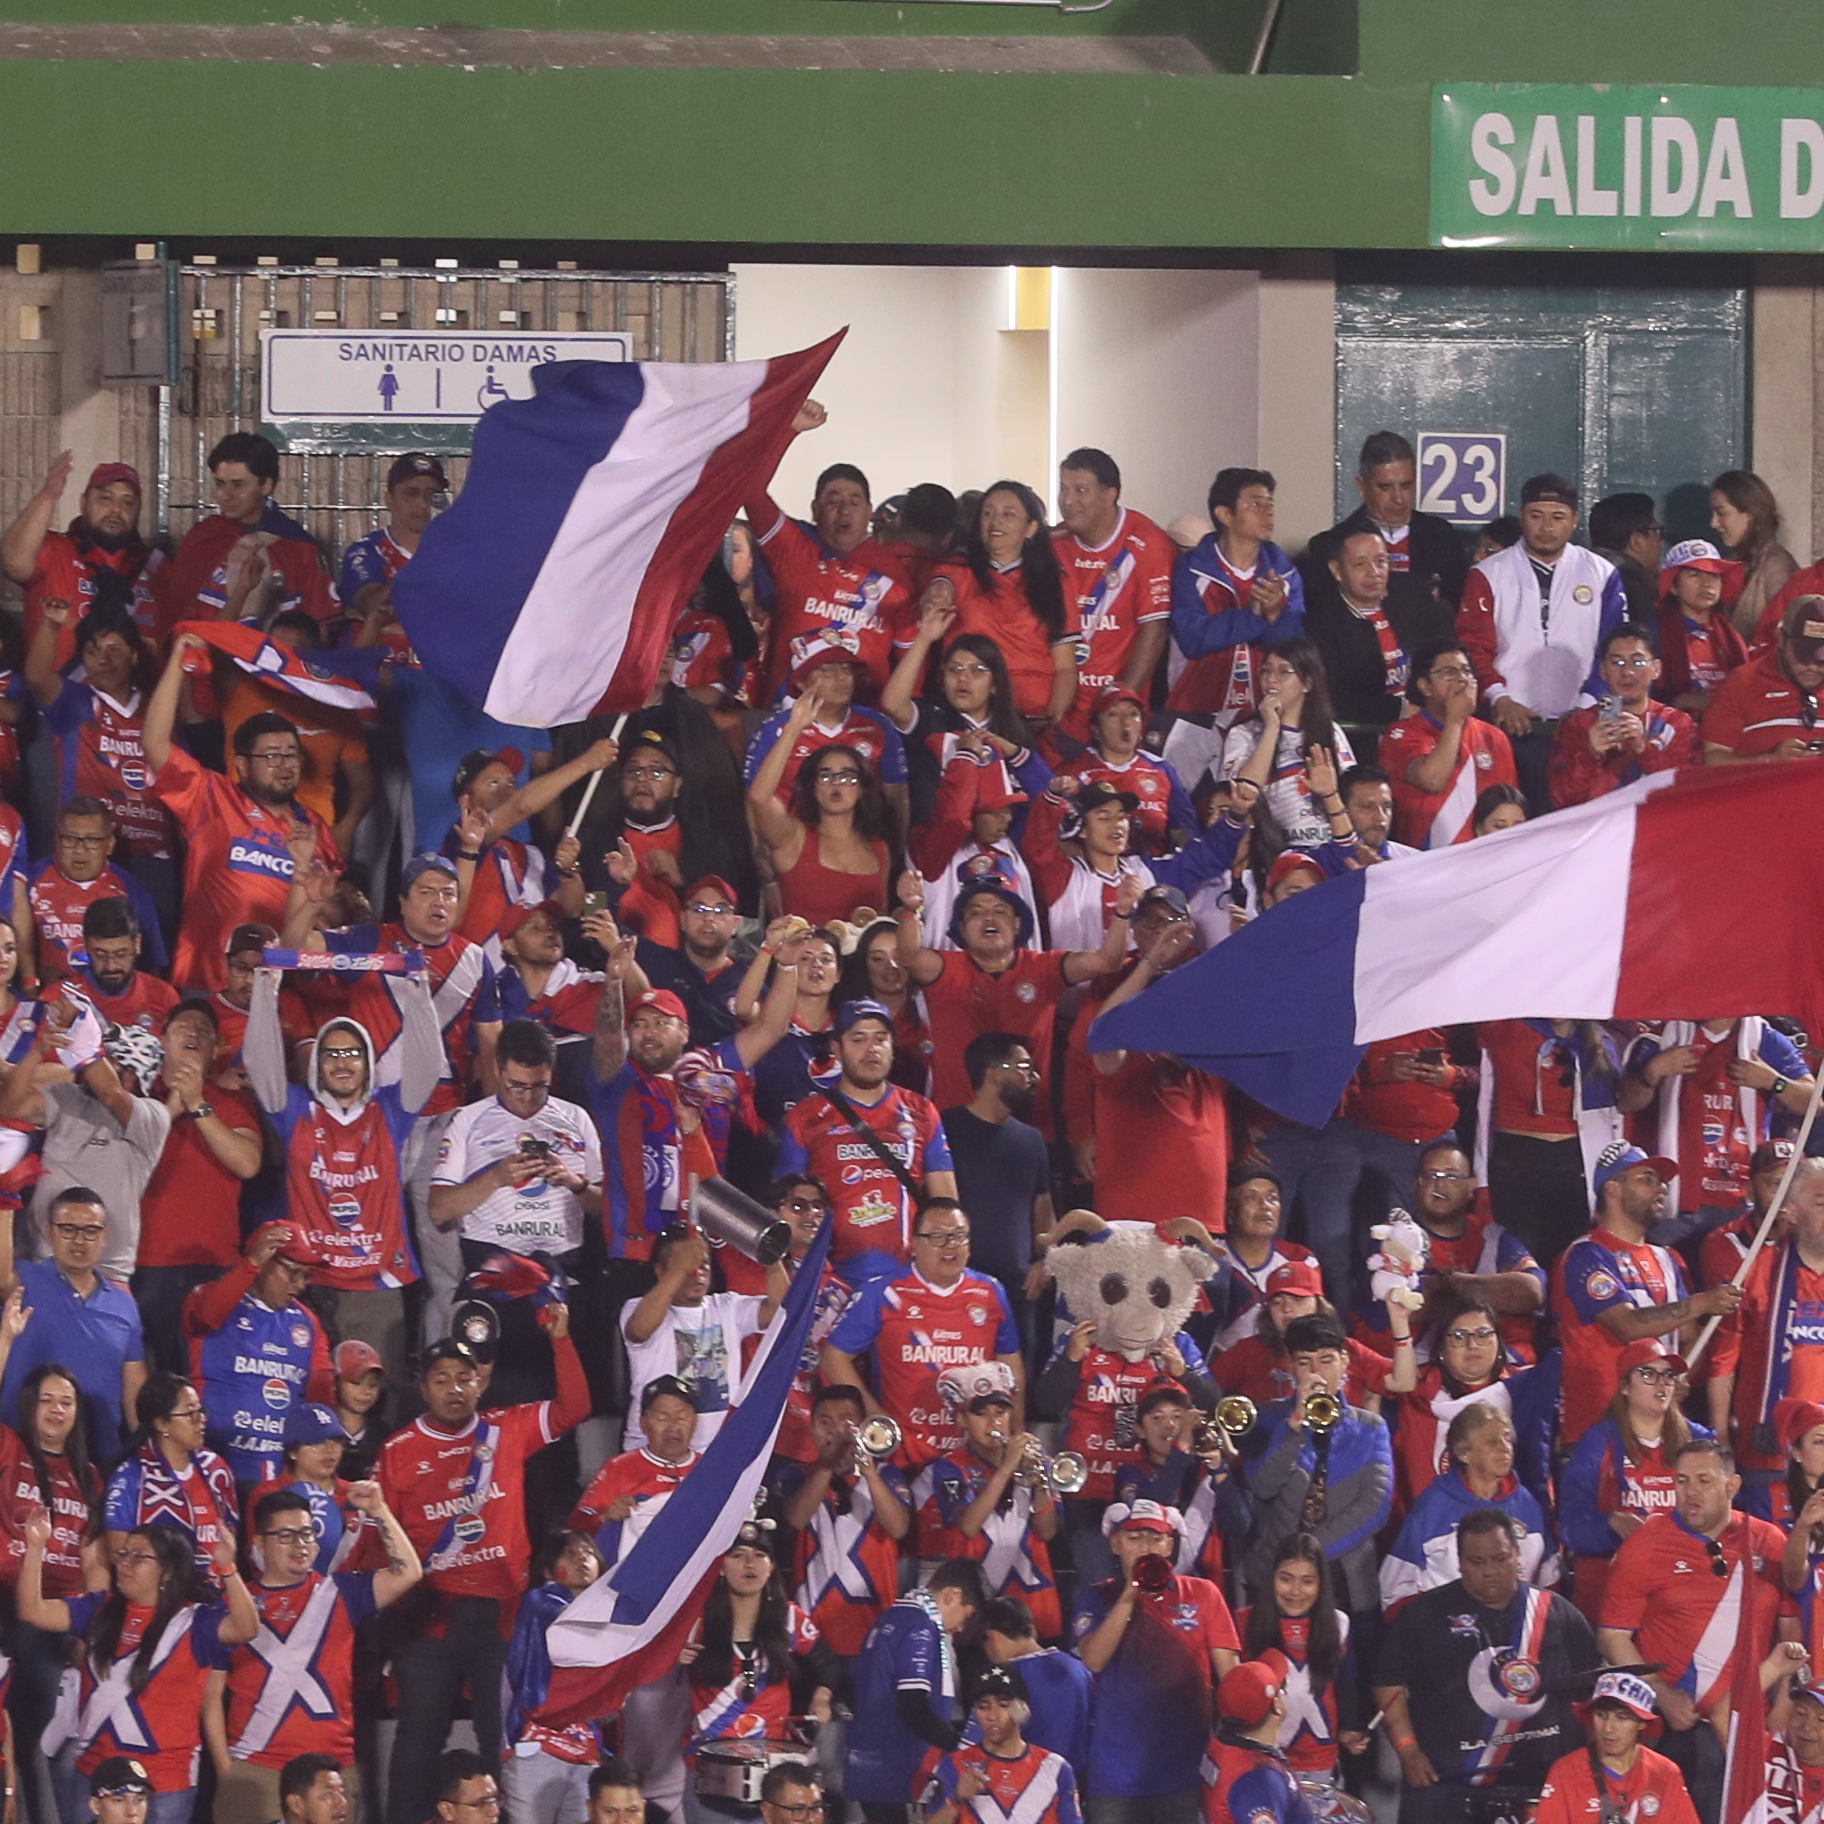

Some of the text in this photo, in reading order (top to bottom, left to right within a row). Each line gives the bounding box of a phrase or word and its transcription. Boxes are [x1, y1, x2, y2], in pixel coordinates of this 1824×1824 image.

[1469, 112, 1753, 218] SALIDA
[339, 342, 557, 364] SANITARIO DAMAS
[1422, 443, 1497, 516] 23
[804, 600, 884, 637] BANRURAL
[495, 1221, 565, 1239] BANRURAL
[901, 1344, 985, 1365] BANRURAL
[234, 1356, 307, 1383] BANRURAL
[423, 1484, 506, 1521] BANRURAL
[454, 1523, 483, 1537] PEPSI
[438, 1545, 506, 1571] elektra
